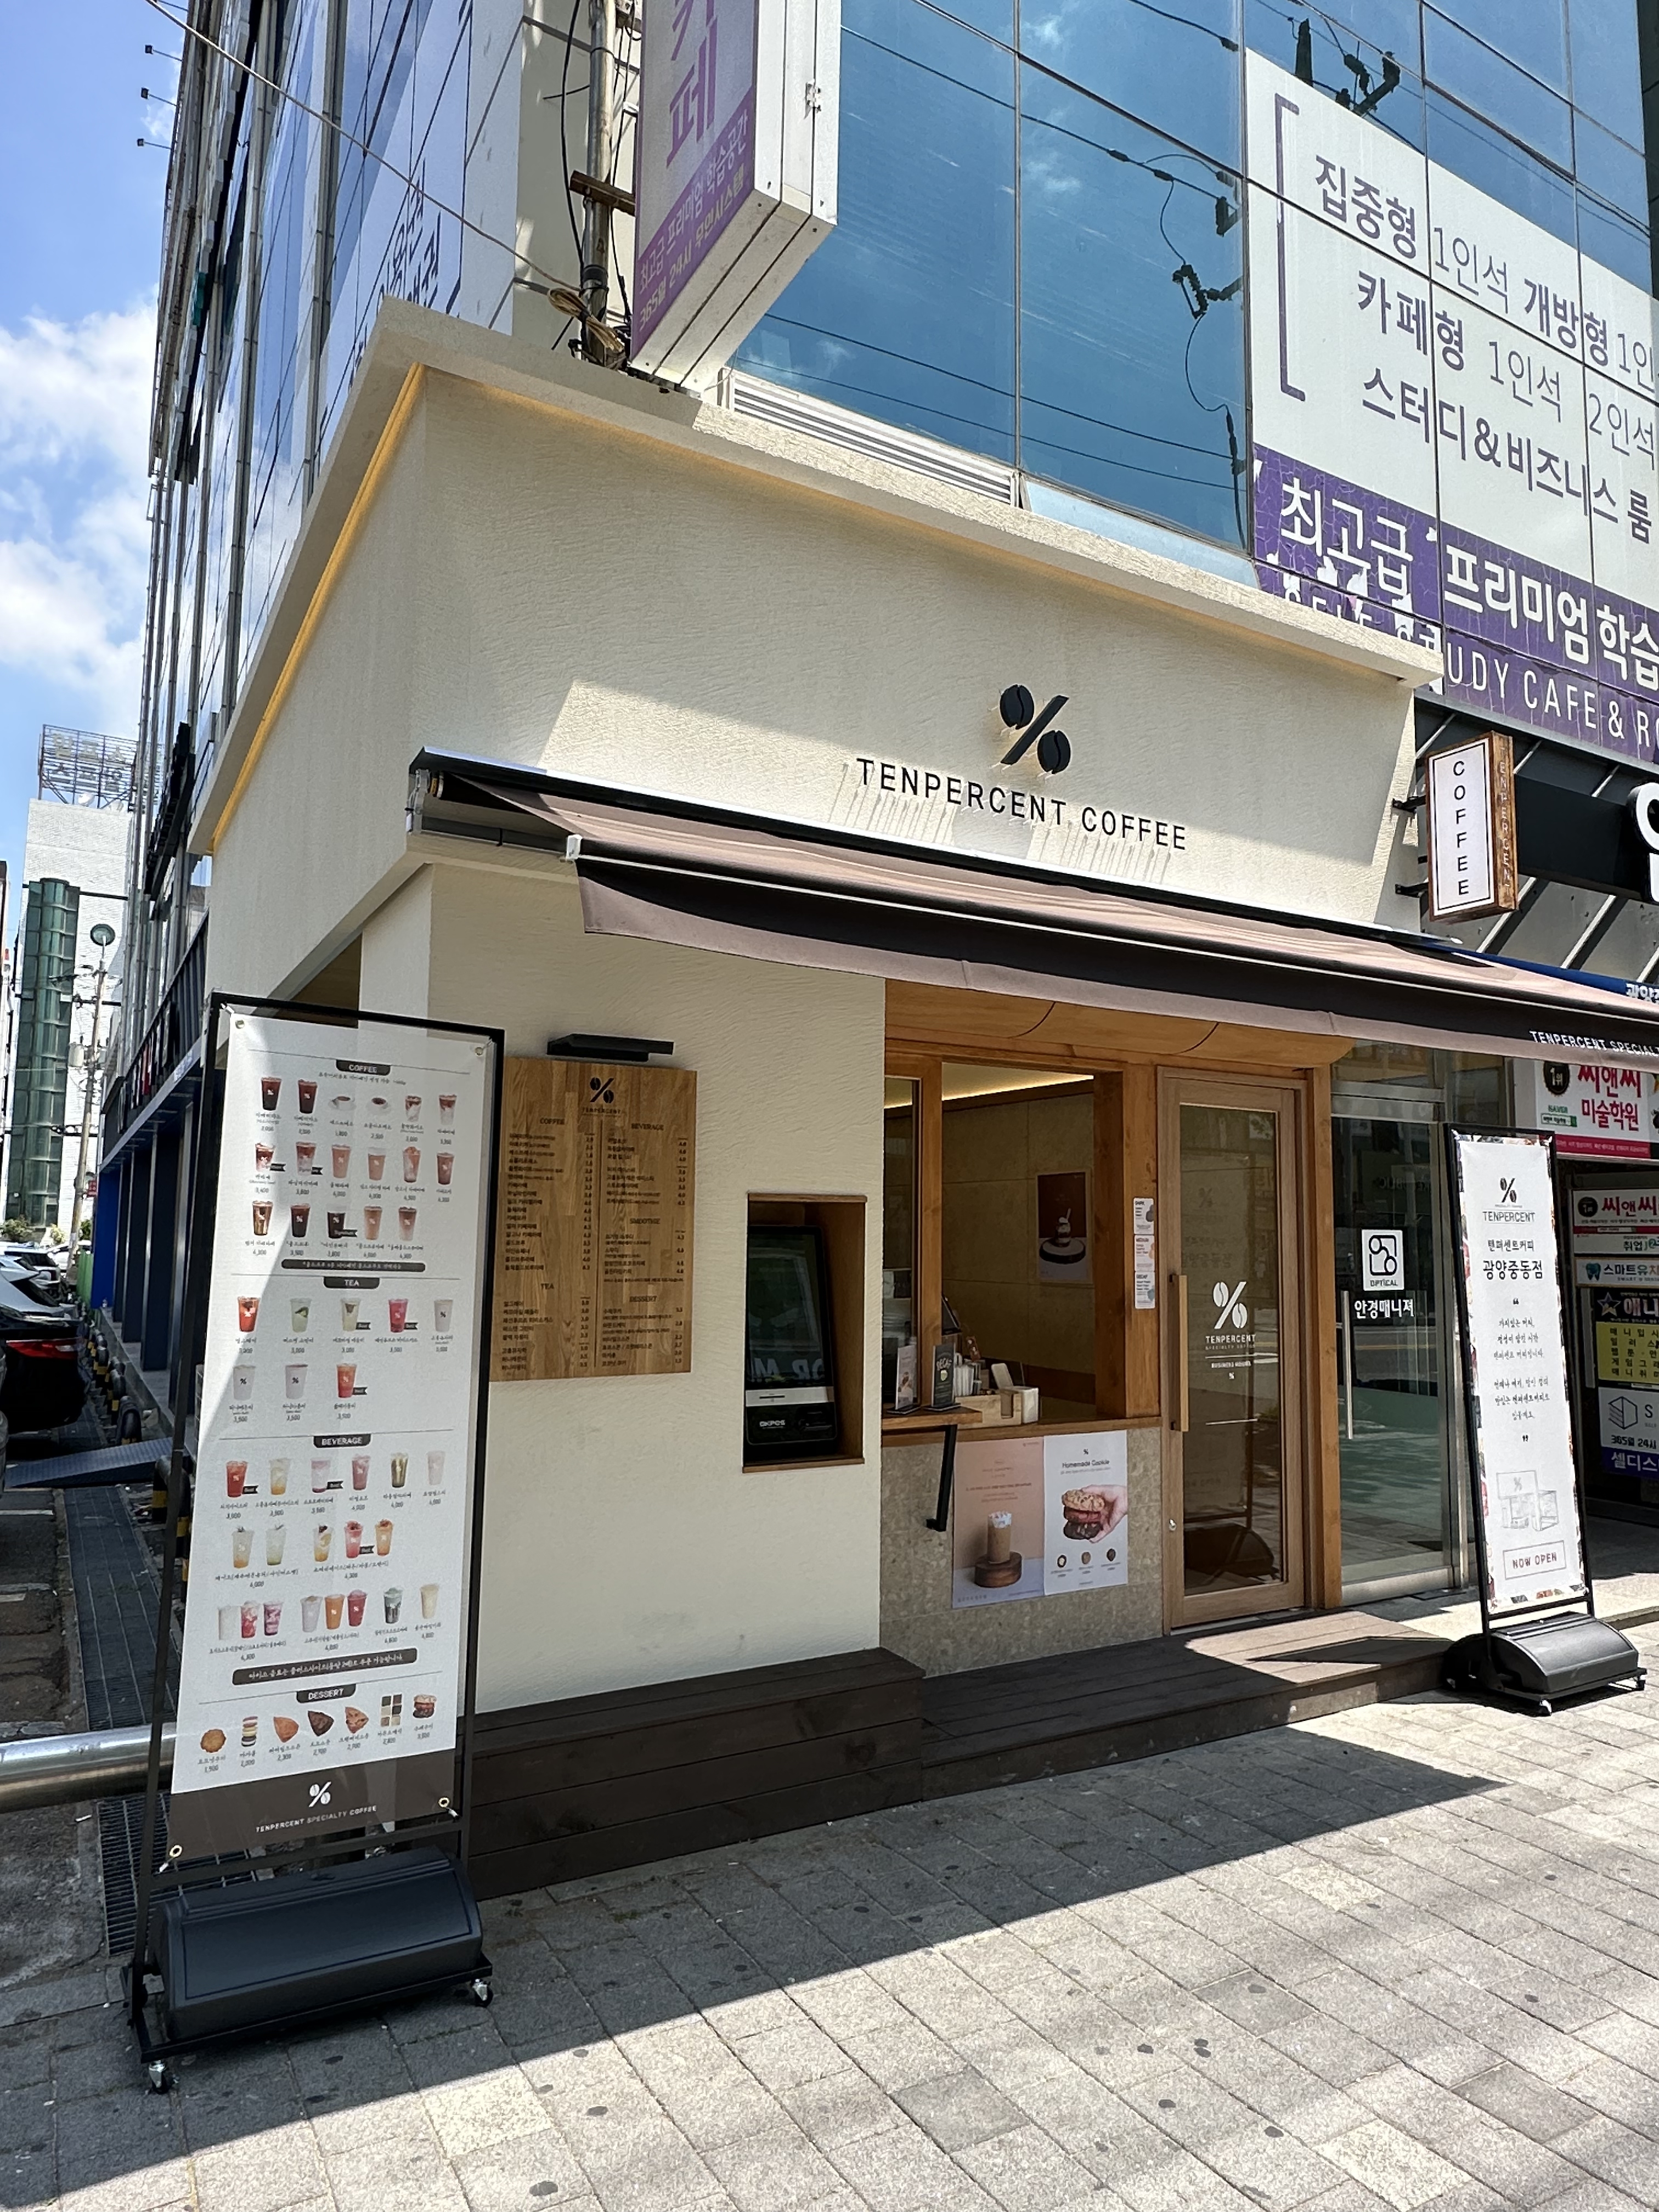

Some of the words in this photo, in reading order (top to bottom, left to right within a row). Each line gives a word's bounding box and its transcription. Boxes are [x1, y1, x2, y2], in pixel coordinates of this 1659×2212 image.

[667, 174, 704, 255] 프리미엄
[706, 109, 748, 194] 학습공간
[1316, 154, 1417, 259] 집중형
[1433, 227, 1509, 314] 1인석
[1523, 278, 1609, 368] 개방형
[1358, 269, 1464, 373] 카페형
[1488, 341, 1561, 423] 1인석
[1589, 393, 1655, 471] 2인석
[1362, 368, 1619, 523] 스터디&비즈니스
[1627, 489, 1651, 544] 룸
[1280, 477, 1414, 597] 최고급
[1444, 545, 1590, 665] 프리미엄
[1447, 642, 1510, 699] UDY
[1523, 669, 1598, 730] CAFE
[1609, 700, 1626, 740] &
[1637, 710, 1659, 747] R
[857, 757, 1066, 826] TENPERCENT
[1081, 806, 1186, 850] COFFEE
[1453, 760, 1470, 896] COFFEE
[1529, 1030, 1607, 1051] TENPERCENT
[348, 1064, 377, 1074] COFFEE
[1578, 1065, 1641, 1098] 씨앤씨
[1581, 1099, 1639, 1131] 미술학원
[1482, 1211, 1536, 1223] TENPERCENT
[1601, 1195, 1657, 1217] 씨앤씨
[1482, 1260, 1543, 1280] 광양중동점
[1205, 1334, 1256, 1344] TENPERCENT
[321, 1437, 363, 1446] BEVERAGE
[1513, 1556, 1532, 1570] NOW
[1535, 1552, 1557, 1565] OPEN
[308, 1688, 345, 1700] DESSERT
[256, 1818, 305, 1833] TENPERCENT
[307, 1810, 348, 1824] SPECIALTY
[349, 1805, 377, 1816] COFFEE
